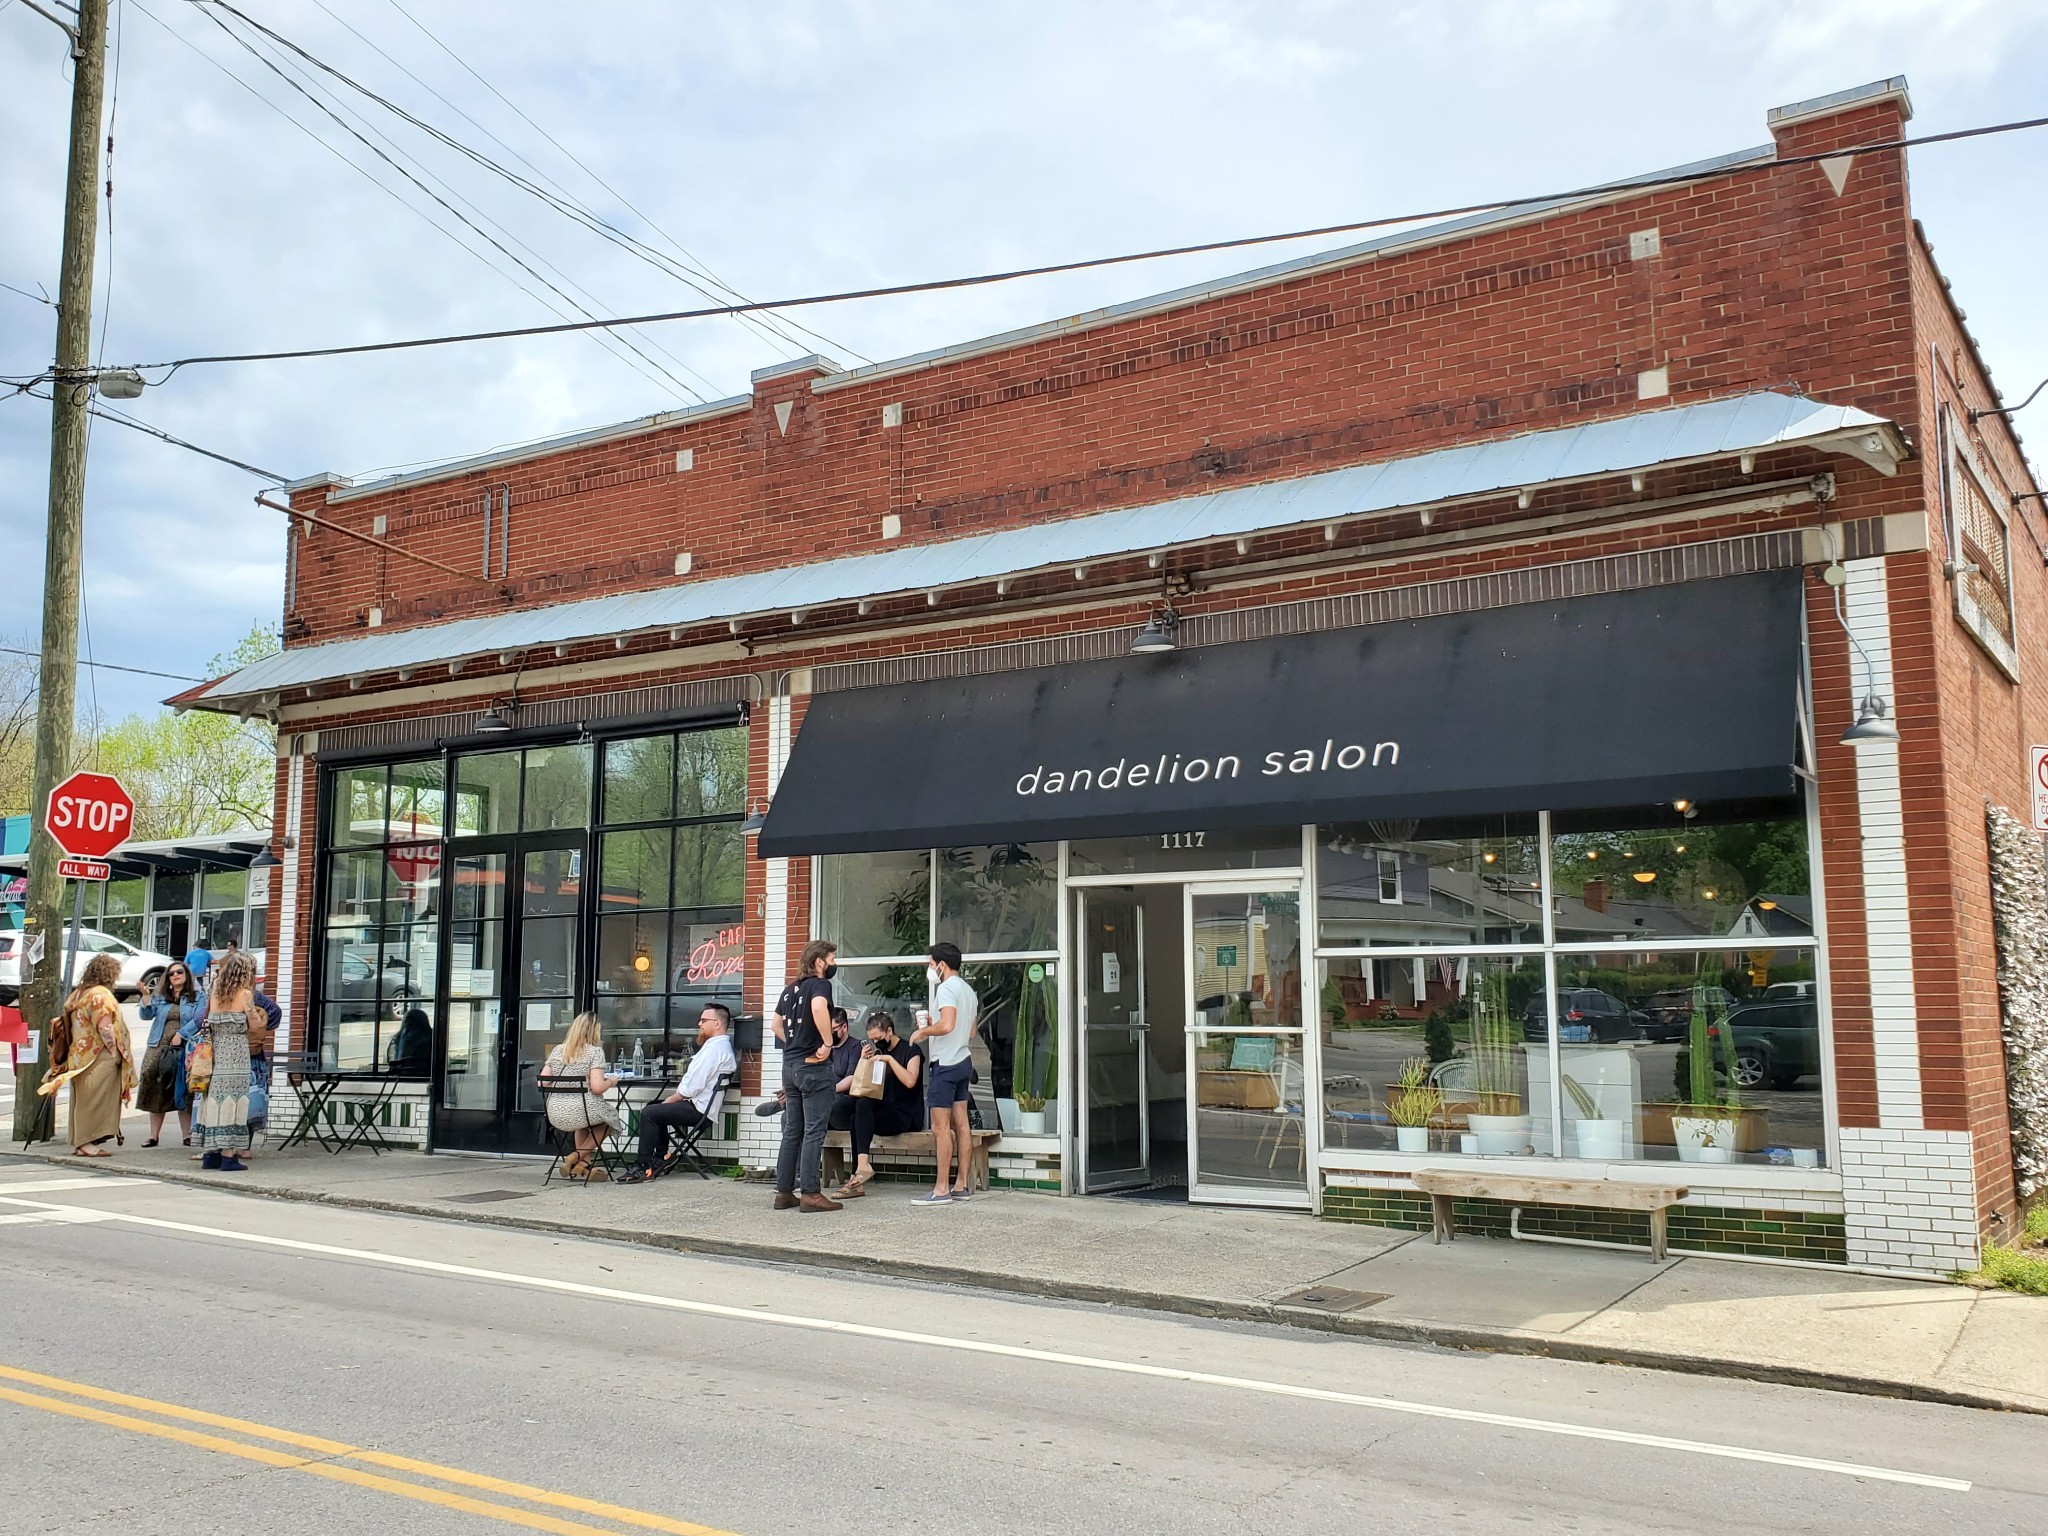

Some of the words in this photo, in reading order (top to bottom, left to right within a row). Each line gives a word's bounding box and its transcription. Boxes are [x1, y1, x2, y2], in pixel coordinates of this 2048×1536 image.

[1015, 753, 1241, 796] dandelion
[1261, 739, 1400, 776] salon
[53, 795, 128, 833] STOP
[1160, 831, 1205, 849] 1117
[62, 863, 80, 875] ALL
[87, 865, 106, 877] WAY
